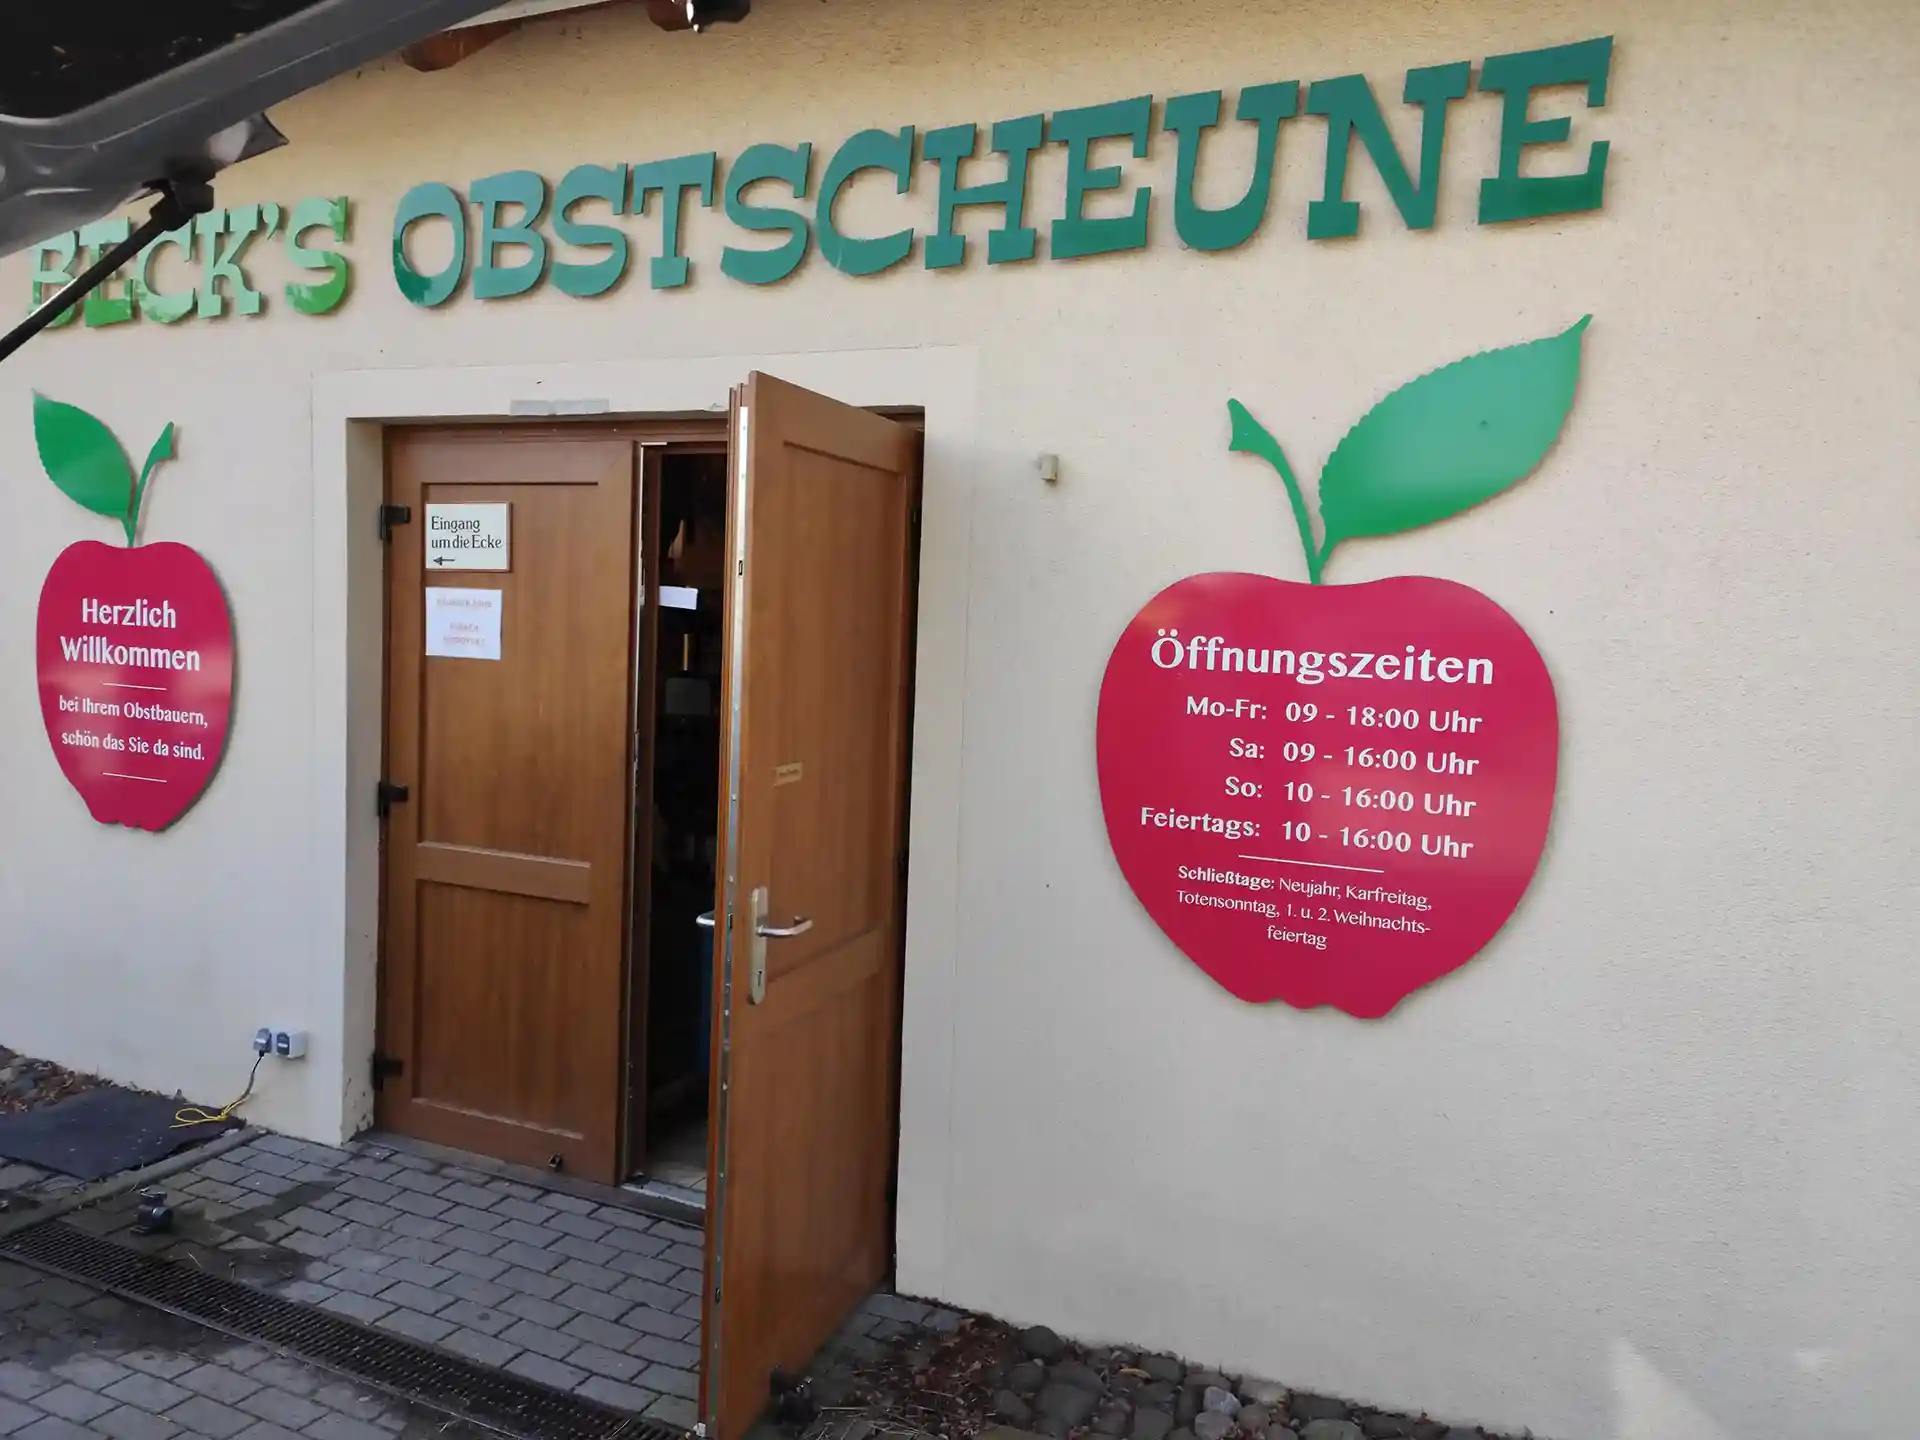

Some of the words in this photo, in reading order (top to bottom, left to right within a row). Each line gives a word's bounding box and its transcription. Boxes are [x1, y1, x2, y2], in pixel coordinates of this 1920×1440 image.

[27, 195, 350, 328] BECK'S
[392, 36, 1614, 308] OBSTSCHEUNE
[431, 515, 481, 533] Eingang
[431, 538, 451, 549] um
[452, 534, 470, 549] die
[471, 534, 502, 549] Ecke
[81, 598, 177, 629] Herzlich
[59, 635, 201, 672] Willkommen
[1151, 628, 1494, 685] Öffnungszeiten
[59, 694, 79, 713] bei
[82, 697, 120, 717] Ihrem
[123, 702, 208, 729] Obstbauern,
[1186, 695, 1267, 720] Mo-Fr:
[1285, 702, 1318, 723] 09
[1346, 705, 1420, 730] 18:00
[1429, 710, 1483, 734] Uhr
[61, 729, 100, 749] schön
[102, 733, 126, 751] das
[128, 736, 150, 754] Sie
[153, 738, 169, 756] da
[172, 741, 206, 761] sind.
[1229, 737, 1265, 759] Sa:
[1283, 741, 1316, 763] 09
[1343, 746, 1417, 771] 16:00
[1426, 751, 1480, 776] Uhr
[1224, 776, 1263, 798] So:
[1284, 781, 1314, 803] 10
[1341, 786, 1415, 812] 16:00
[1424, 792, 1477, 817] Uhr
[1141, 806, 1261, 840] Feiertags:
[1282, 820, 1311, 842] 10
[1339, 826, 1412, 853] 16:00
[1421, 834, 1474, 859] Uhr
[1178, 865, 1275, 891] Schließtage:
[1279, 877, 1342, 900] Neujahr,
[1346, 885, 1432, 912] Karfreitag,
[1176, 890, 1280, 918] Totensonntag,
[1286, 903, 1297, 917] 1.
[1301, 907, 1313, 920] u.
[1317, 907, 1331, 921] 2.
[1333, 909, 1431, 934] Weihnachts-
[1267, 924, 1327, 950] feiertag
